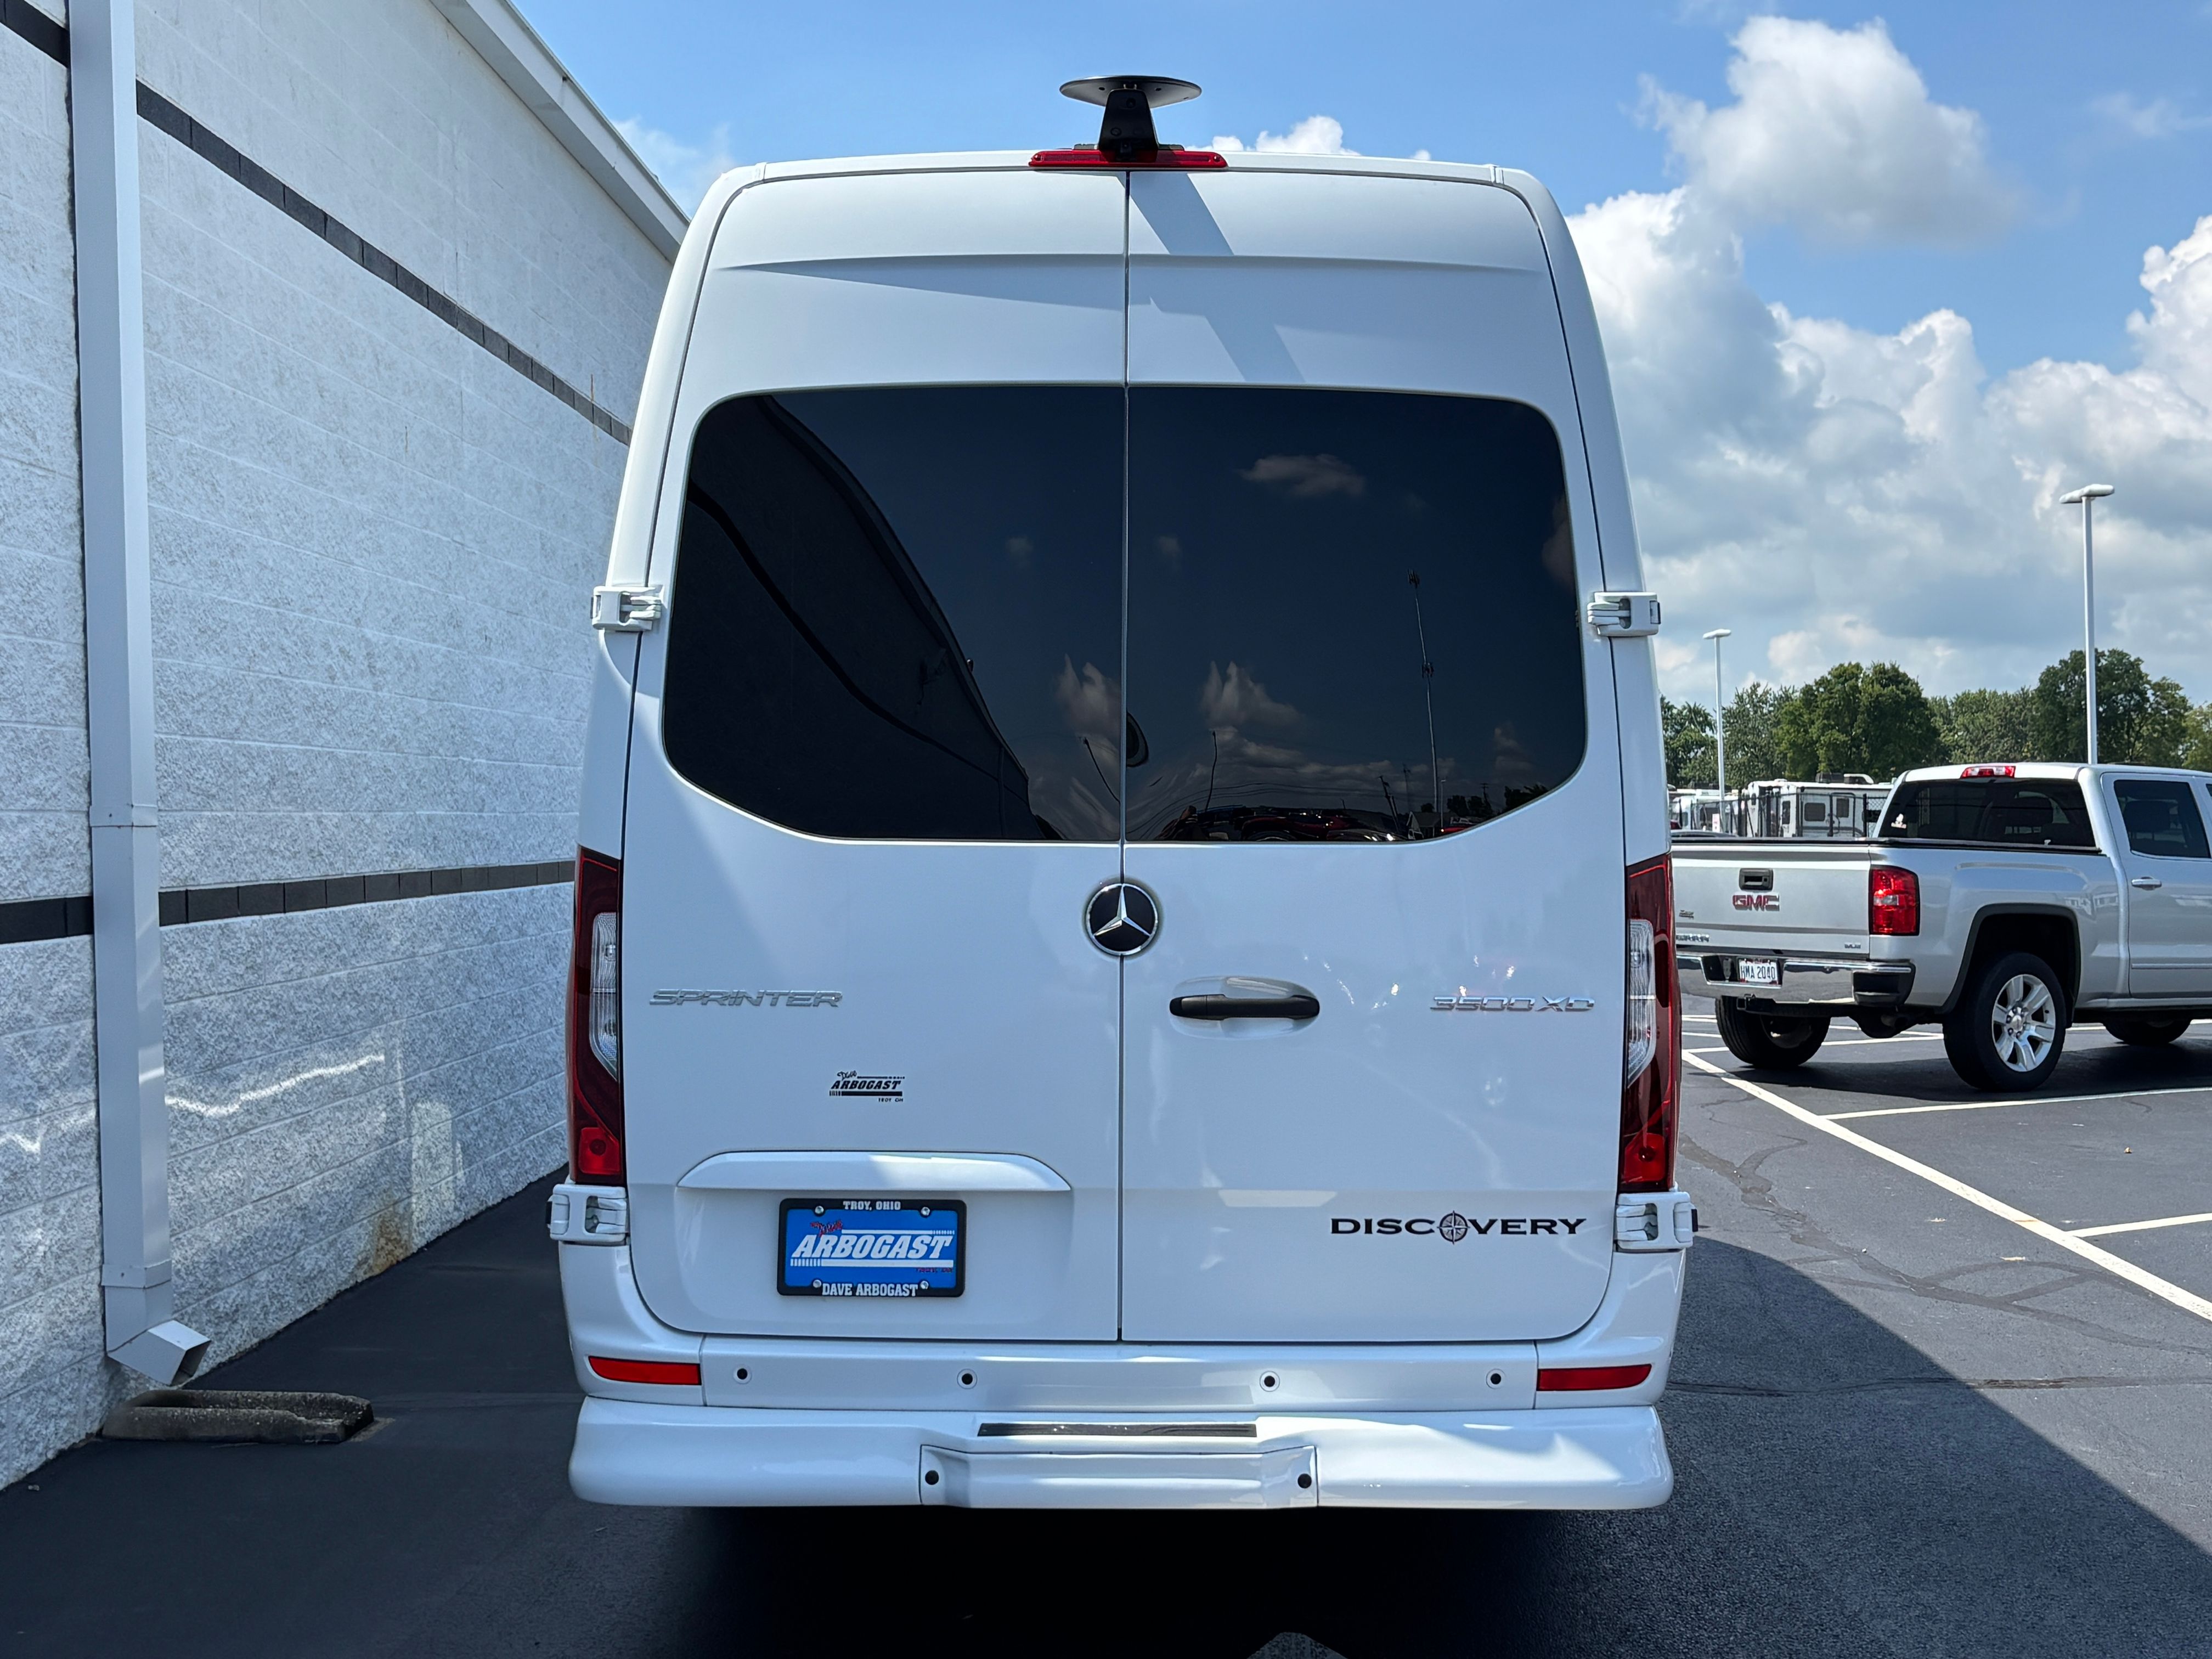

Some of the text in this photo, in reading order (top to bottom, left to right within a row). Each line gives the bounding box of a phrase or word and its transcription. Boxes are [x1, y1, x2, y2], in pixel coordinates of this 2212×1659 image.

[1733, 895, 1780, 911] GMC
[649, 989, 843, 1007] SPRINTER
[831, 1080, 901, 1090] ARBOGAST
[843, 1201, 901, 1211] TROY, OHIO
[791, 1234, 953, 1259] ARBOGAST
[822, 1283, 918, 1297] DAVE ARBOGAST
